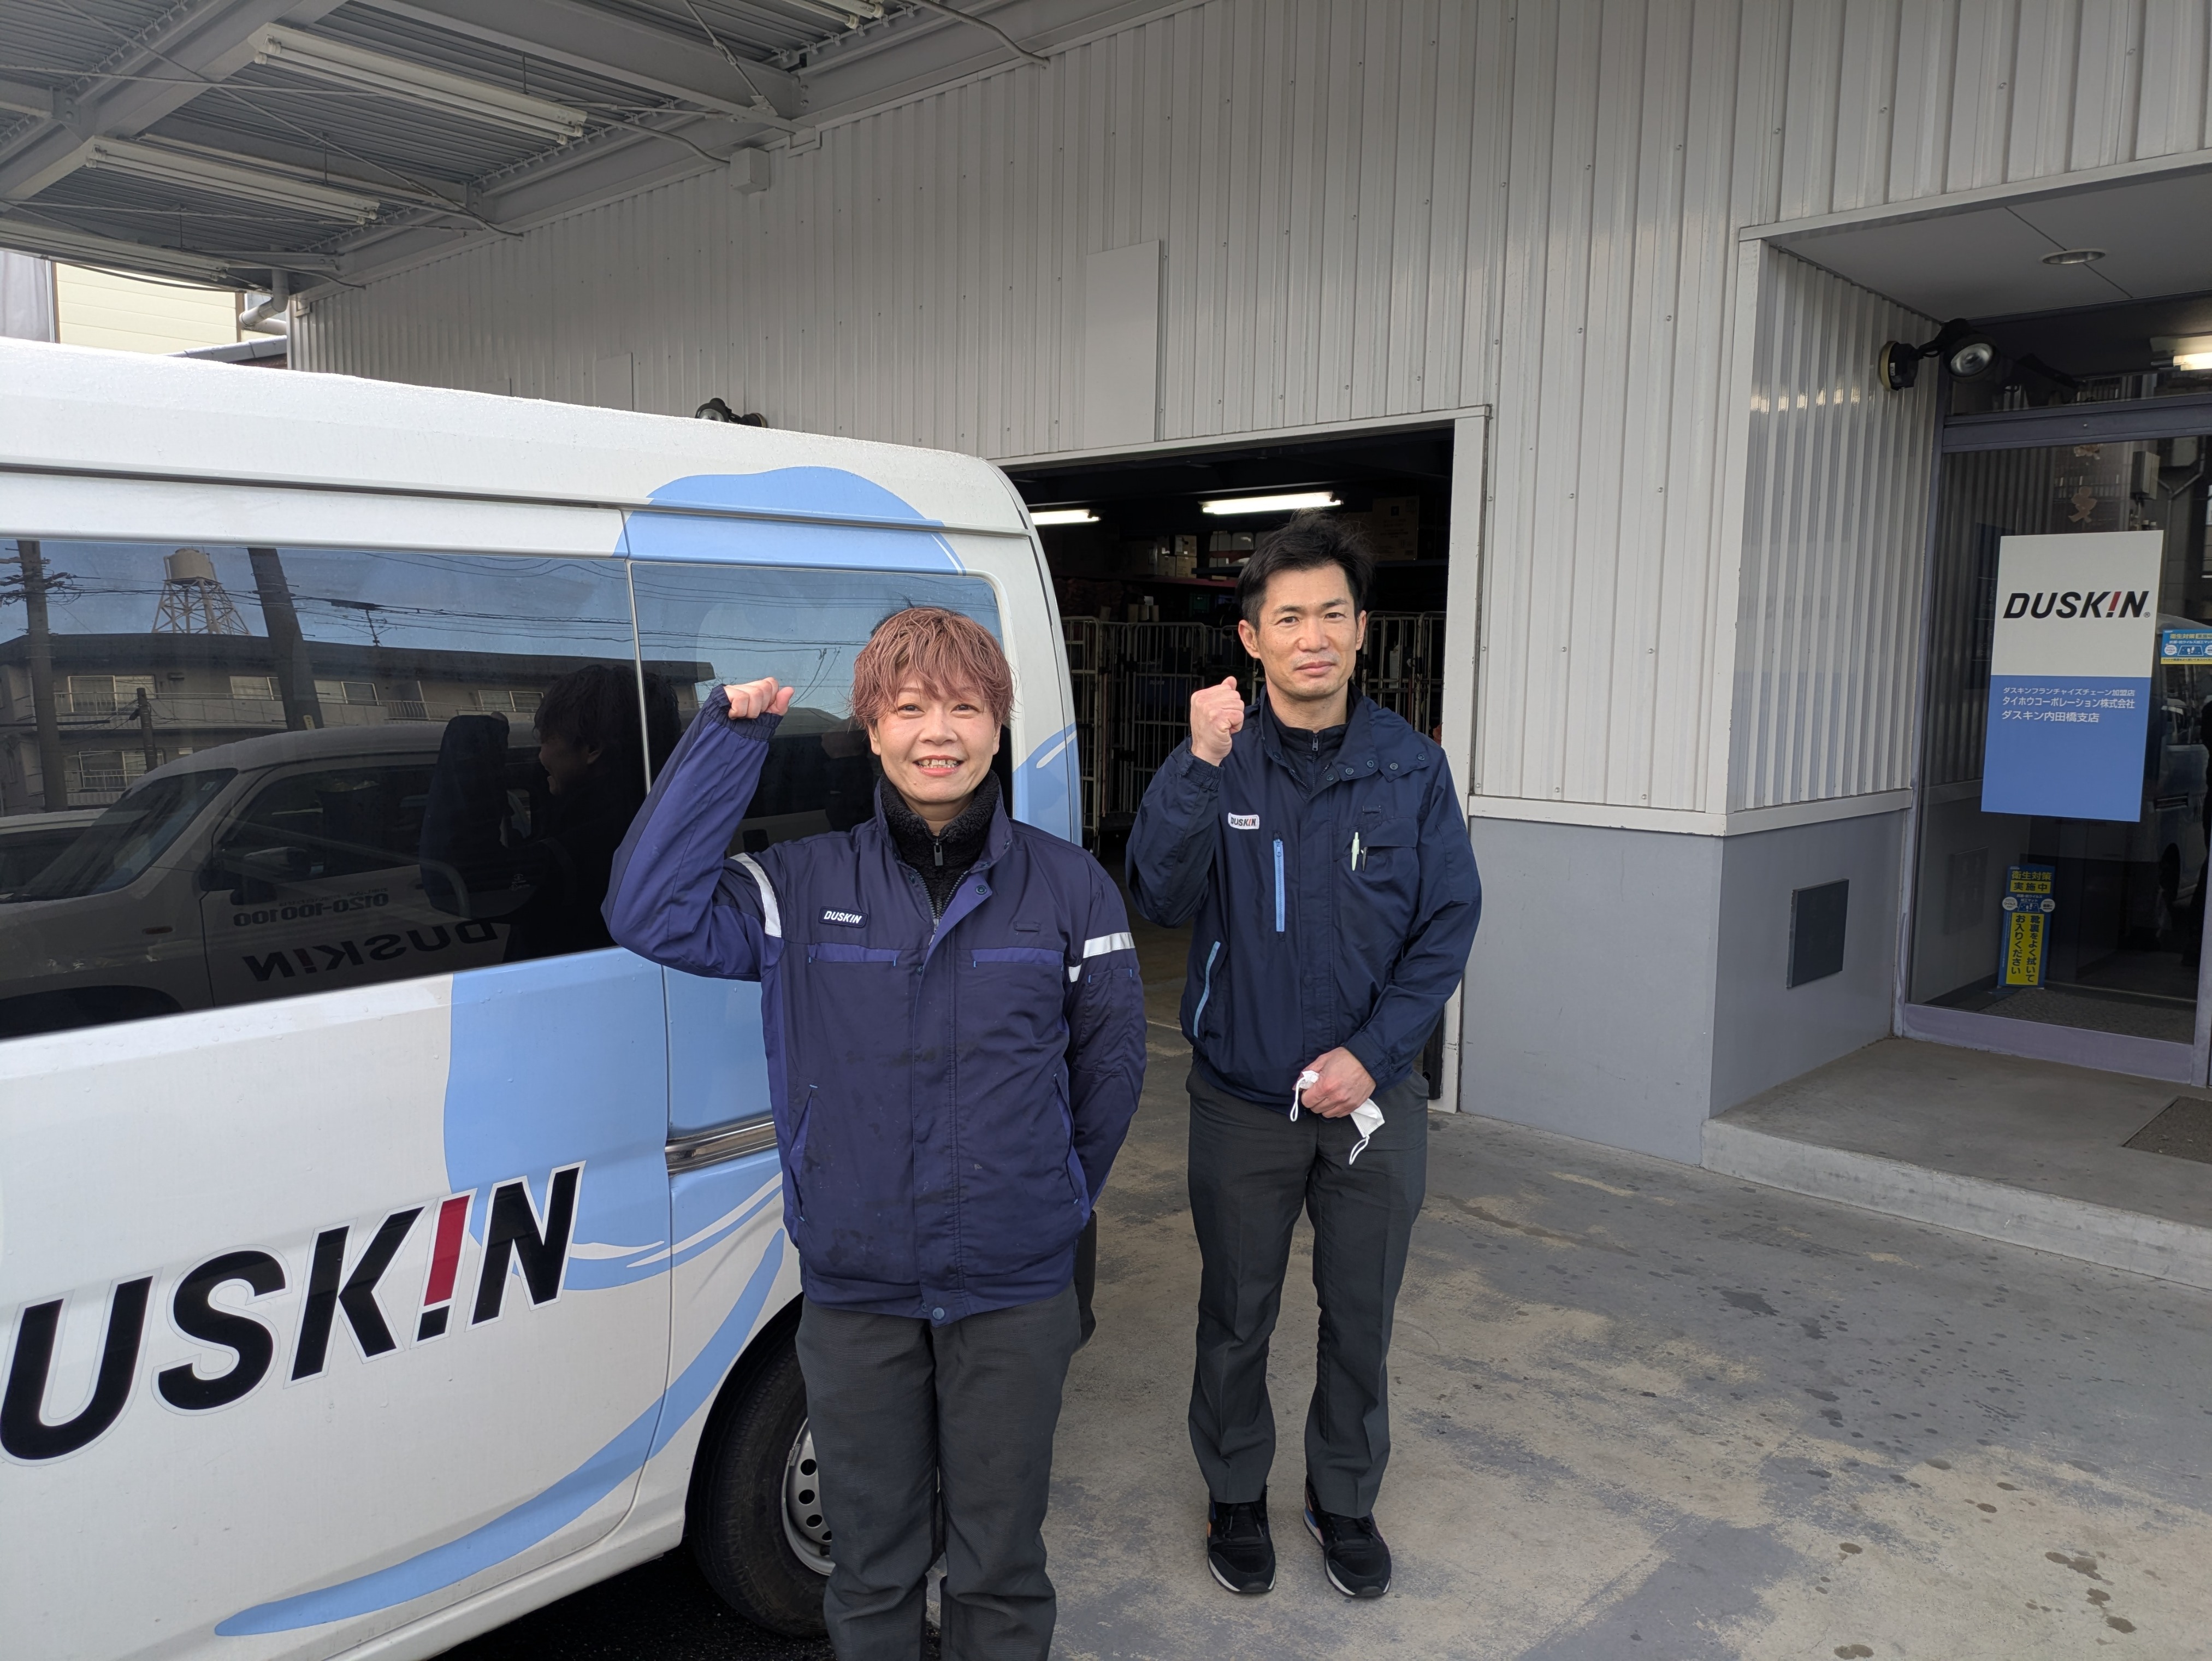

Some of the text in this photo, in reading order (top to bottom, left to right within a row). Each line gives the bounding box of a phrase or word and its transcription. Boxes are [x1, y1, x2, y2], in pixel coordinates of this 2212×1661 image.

[2003, 687, 2135, 696] ダスキンフランチャイズチェーン加盟店
[2002, 696, 2135, 708] タイホウコーポレーション株式会社
[2002, 711, 2099, 723] ダスキン内田橋支店
[2012, 871, 2052, 880] 衛生対策
[2014, 882, 2048, 891] 実施中
[2011, 915, 2026, 974] お入りください
[2026, 915, 2041, 982] 靴裏をよく拭いて
